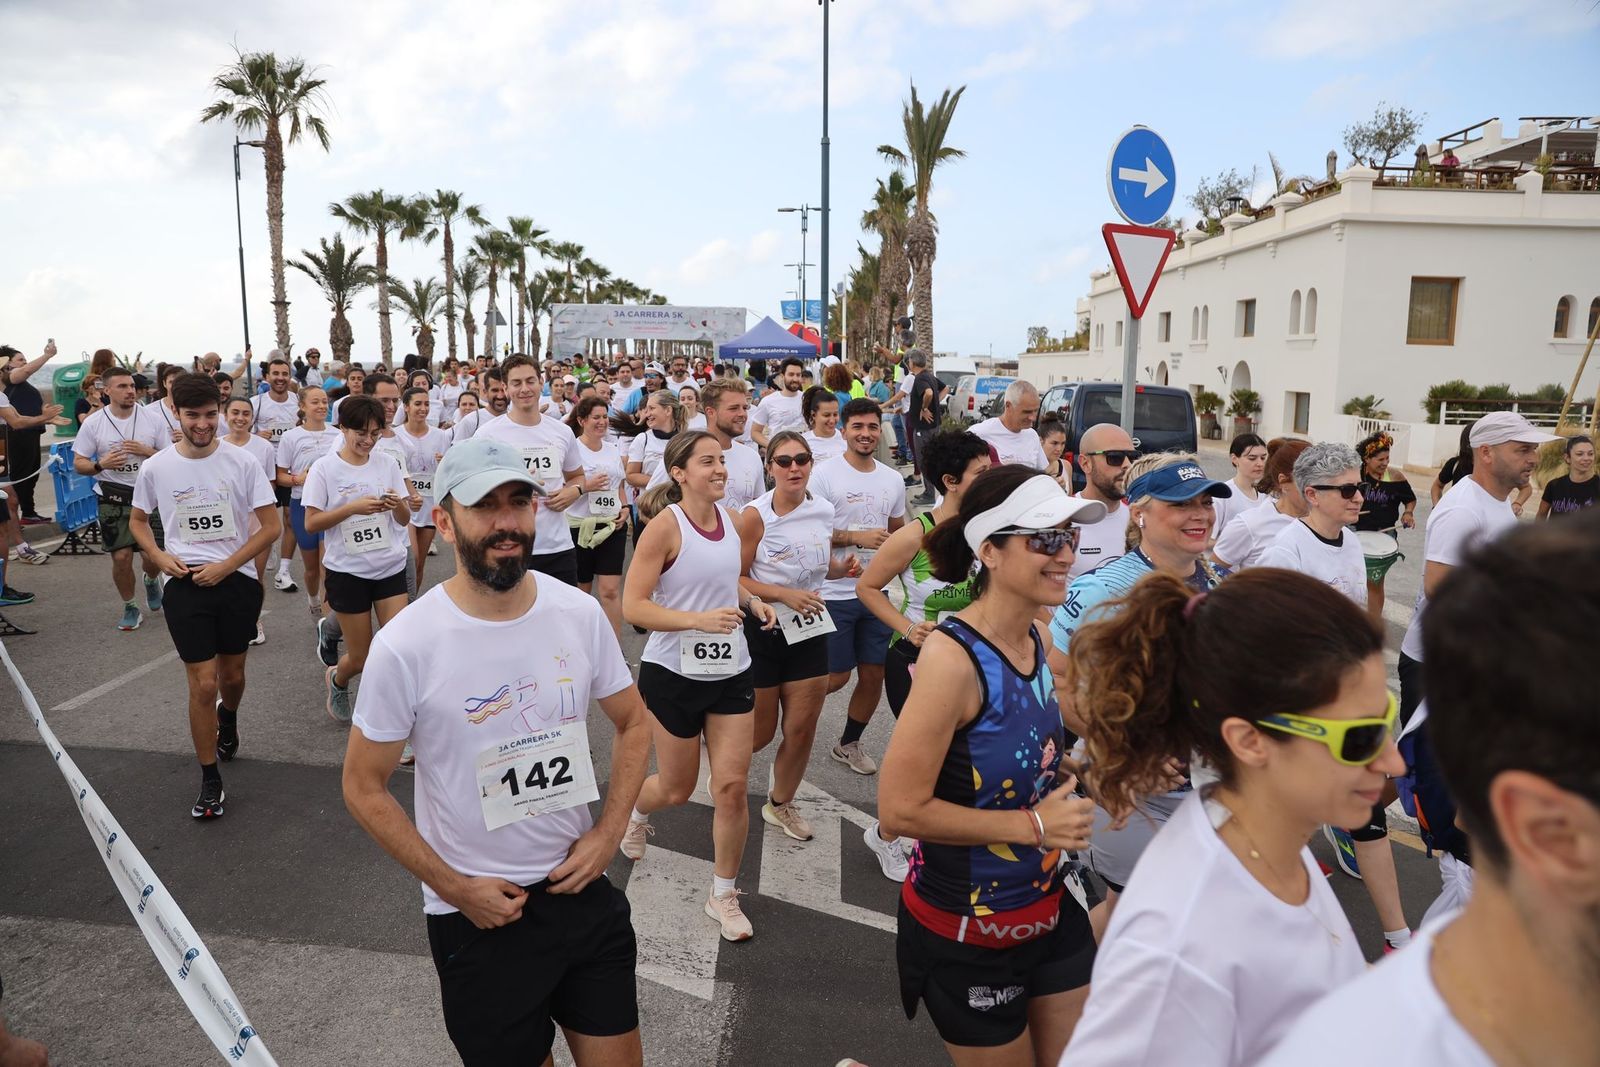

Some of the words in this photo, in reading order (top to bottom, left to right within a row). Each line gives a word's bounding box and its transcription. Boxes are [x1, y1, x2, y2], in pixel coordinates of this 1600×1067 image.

[614, 310, 625, 318] 3A
[627, 310, 670, 319] CARRERA
[672, 311, 683, 319] 5K
[524, 456, 551, 469] 713
[411, 480, 431, 490] 284
[595, 496, 615, 507] 496
[188, 514, 224, 531] 595
[352, 526, 382, 543] 851
[694, 642, 732, 660] 632
[510, 734, 550, 748] CARRERA
[551, 730, 562, 739] 5K
[500, 756, 574, 797] 142
